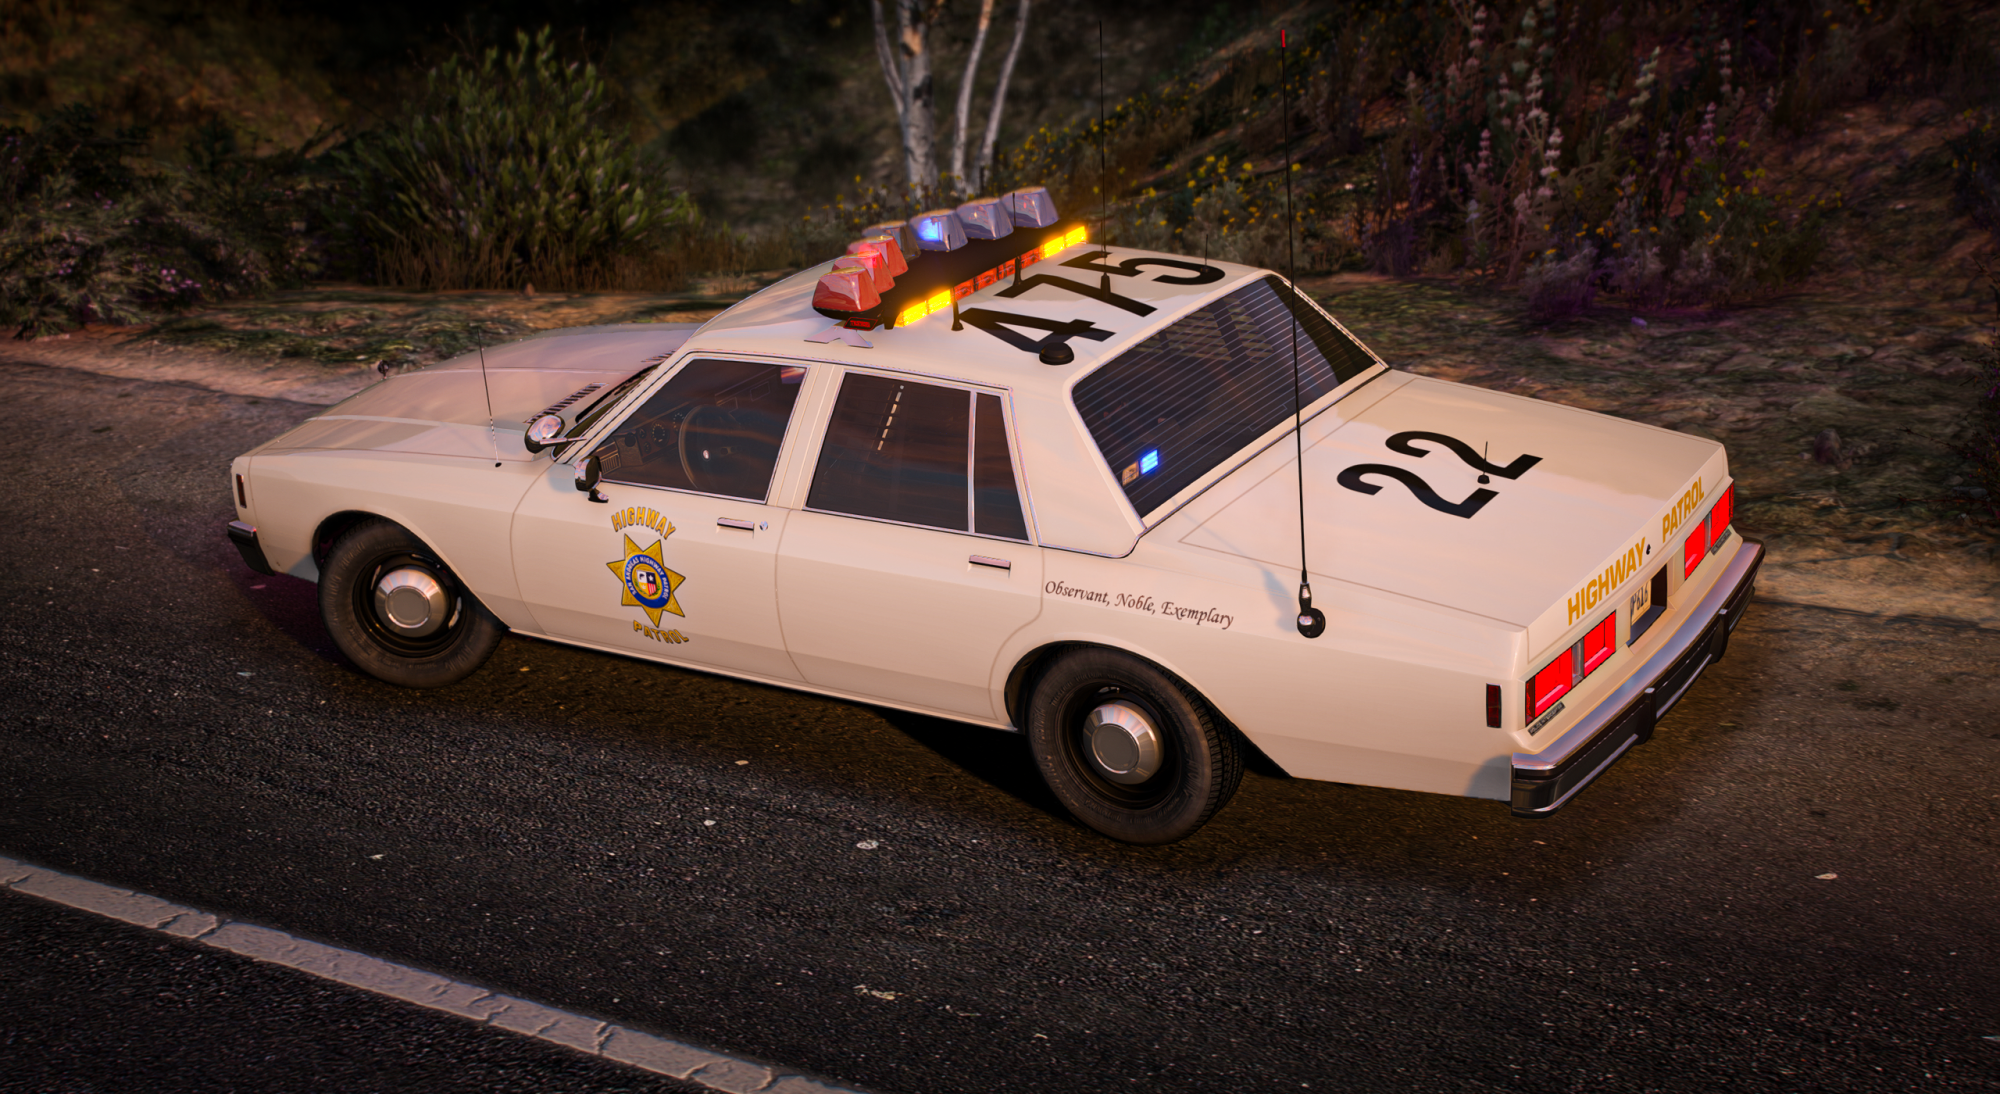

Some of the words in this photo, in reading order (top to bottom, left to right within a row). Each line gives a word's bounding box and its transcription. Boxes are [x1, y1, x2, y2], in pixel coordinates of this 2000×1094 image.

[958, 250, 1226, 355] 475
[1336, 430, 1544, 519] 22
[611, 506, 676, 540] HIGHWAY
[1567, 536, 1646, 626] HIGHWAY
[1662, 476, 1705, 543] PATROL
[633, 620, 689, 644] PATROL
[1045, 581, 1111, 606] Observant,
[1114, 593, 1156, 615] Noble,
[1161, 601, 1235, 630] Exemplary
